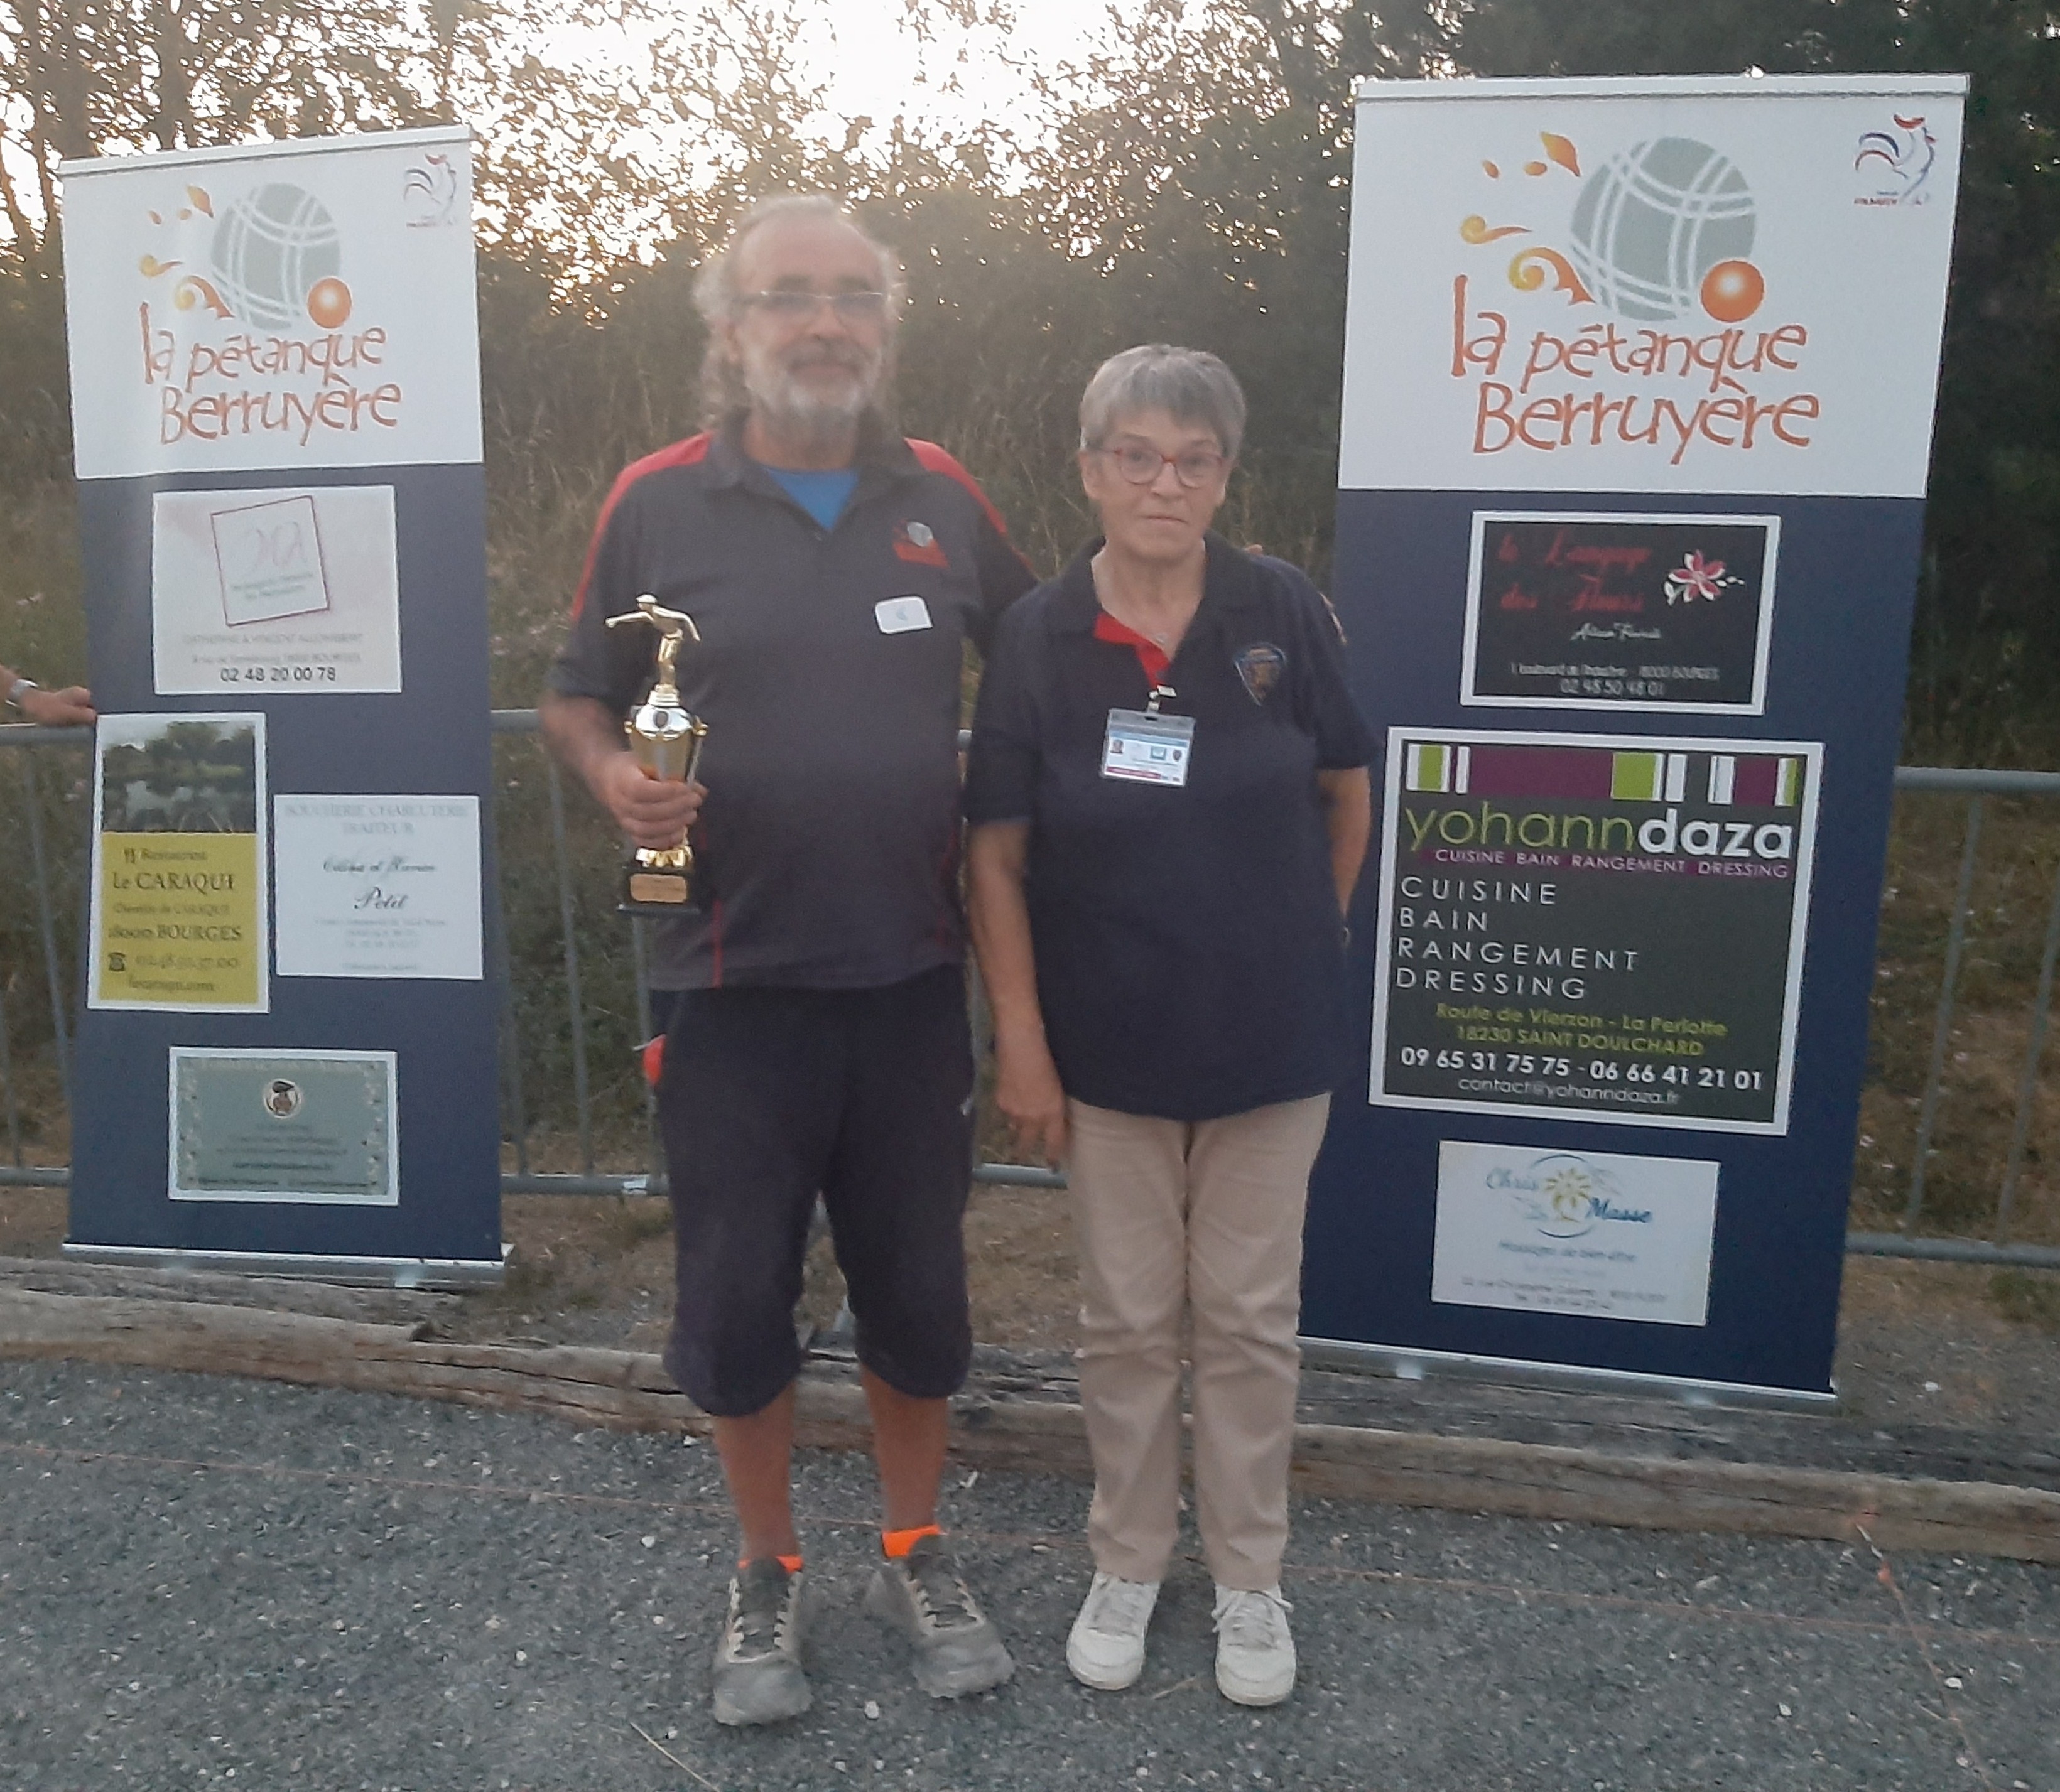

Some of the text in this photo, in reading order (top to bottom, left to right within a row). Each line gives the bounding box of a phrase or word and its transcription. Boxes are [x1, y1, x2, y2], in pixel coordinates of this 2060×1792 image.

[140, 301, 386, 394] la pétanque
[1451, 274, 1808, 394] la pétanque
[160, 372, 401, 447] Berruyère
[1473, 377, 1820, 465] Berruyère
[220, 667, 239, 682] 02
[244, 667, 265, 681] 48
[293, 667, 312, 681] 00
[1435, 849, 1788, 878] CUISINE BAIN RANGEMENT DRESSING
[136, 871, 234, 896] CARAQUI
[1401, 876, 1556, 905] CUISINE
[157, 924, 242, 941] BOURGES
[1398, 906, 1488, 932] BAIN
[1397, 936, 1639, 971] RANGEMENT
[1395, 966, 1586, 1000] DRESSING
[1436, 1003, 1492, 1020] Route
[1496, 1007, 1524, 1023] de
[1529, 1008, 1603, 1028] Vierzon
[1622, 1014, 1645, 1031] La
[1517, 1028, 1574, 1047] SAINT
[1401, 1046, 1430, 1066] 09
[1436, 1049, 1465, 1069] 65
[1470, 1051, 1497, 1071] 31
[1506, 1053, 1535, 1074] 75
[1541, 1055, 1570, 1077] 75
[1590, 1059, 1618, 1081] 06
[1626, 1063, 1656, 1083] 66
[1661, 1064, 1689, 1085] 41
[1696, 1066, 1726, 1088] 21
[1733, 1070, 1762, 1091] 01
